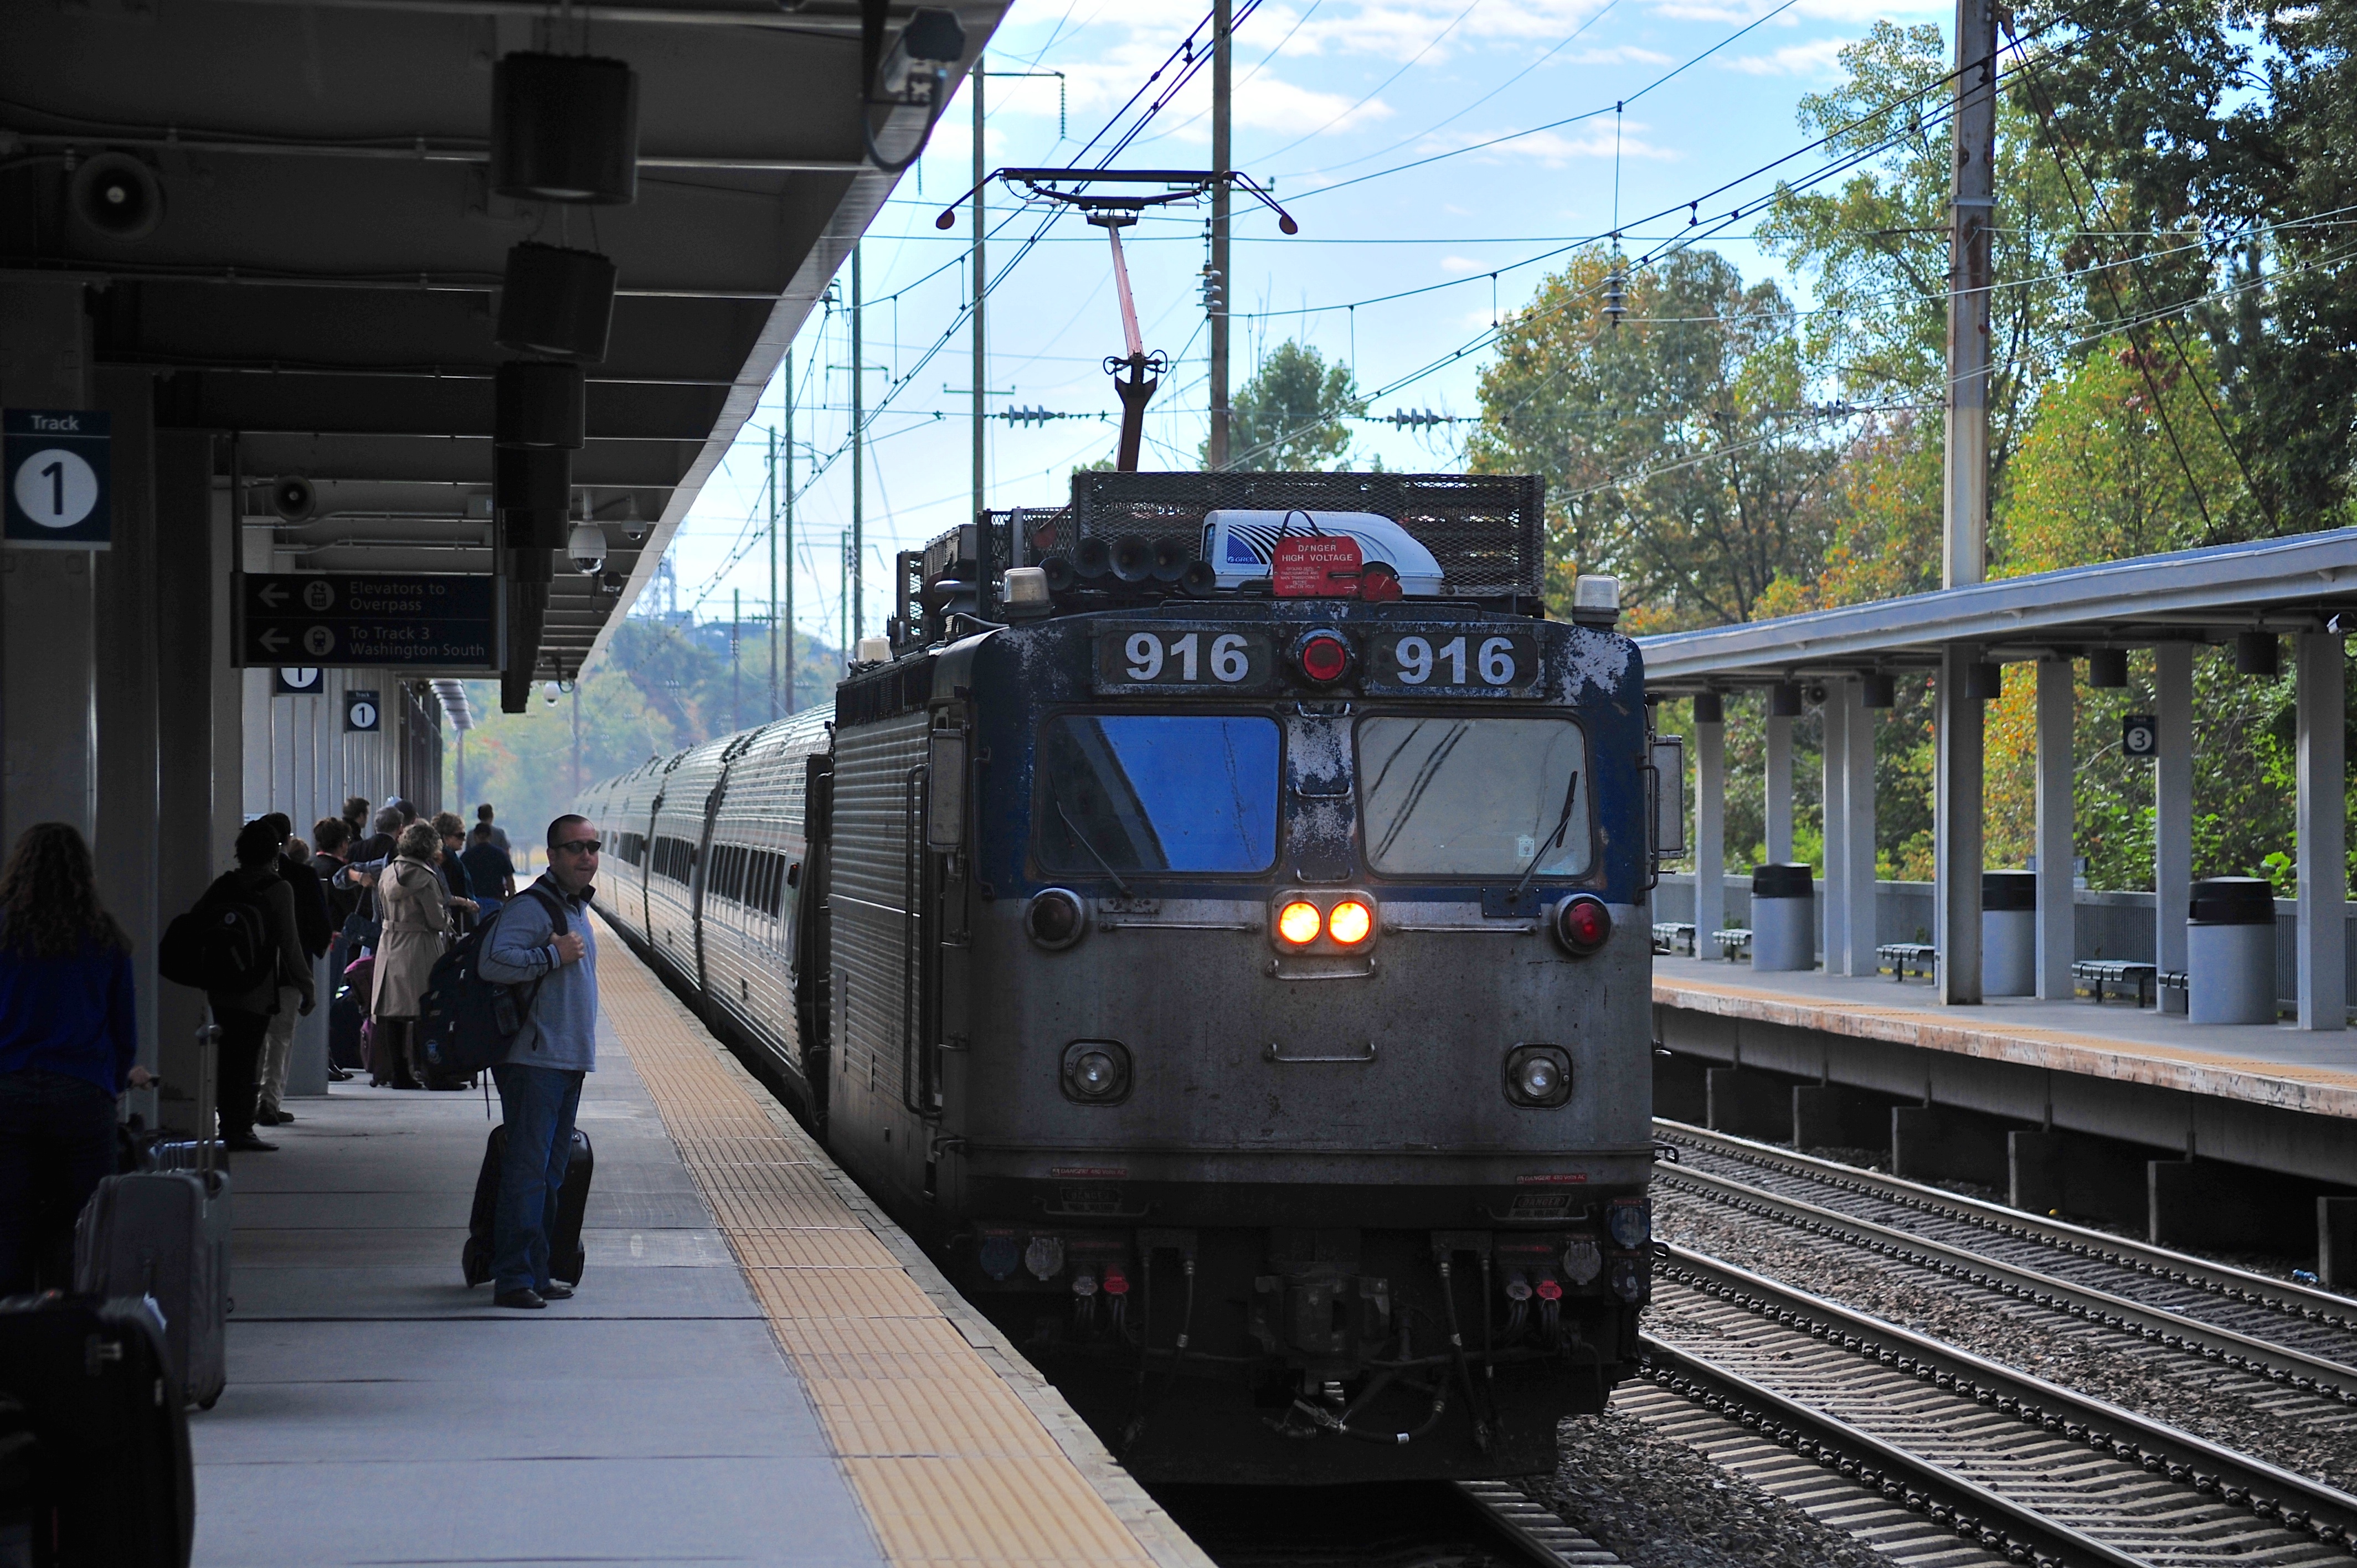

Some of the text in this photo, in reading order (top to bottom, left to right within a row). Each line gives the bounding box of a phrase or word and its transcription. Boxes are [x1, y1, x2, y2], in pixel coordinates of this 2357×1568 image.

[31, 414, 79, 431] Track
[41, 461, 63, 515] 1
[350, 581, 445, 595] Elevators to
[350, 597, 421, 613] Overpass
[349, 626, 430, 639] To Track 3
[349, 642, 485, 658] Washington South
[1125, 632, 1249, 682] 916
[1395, 636, 1516, 685] 916
[359, 706, 365, 723] 1
[2135, 730, 2145, 747] 3
[1524, 1197, 1561, 1206] DANGER
